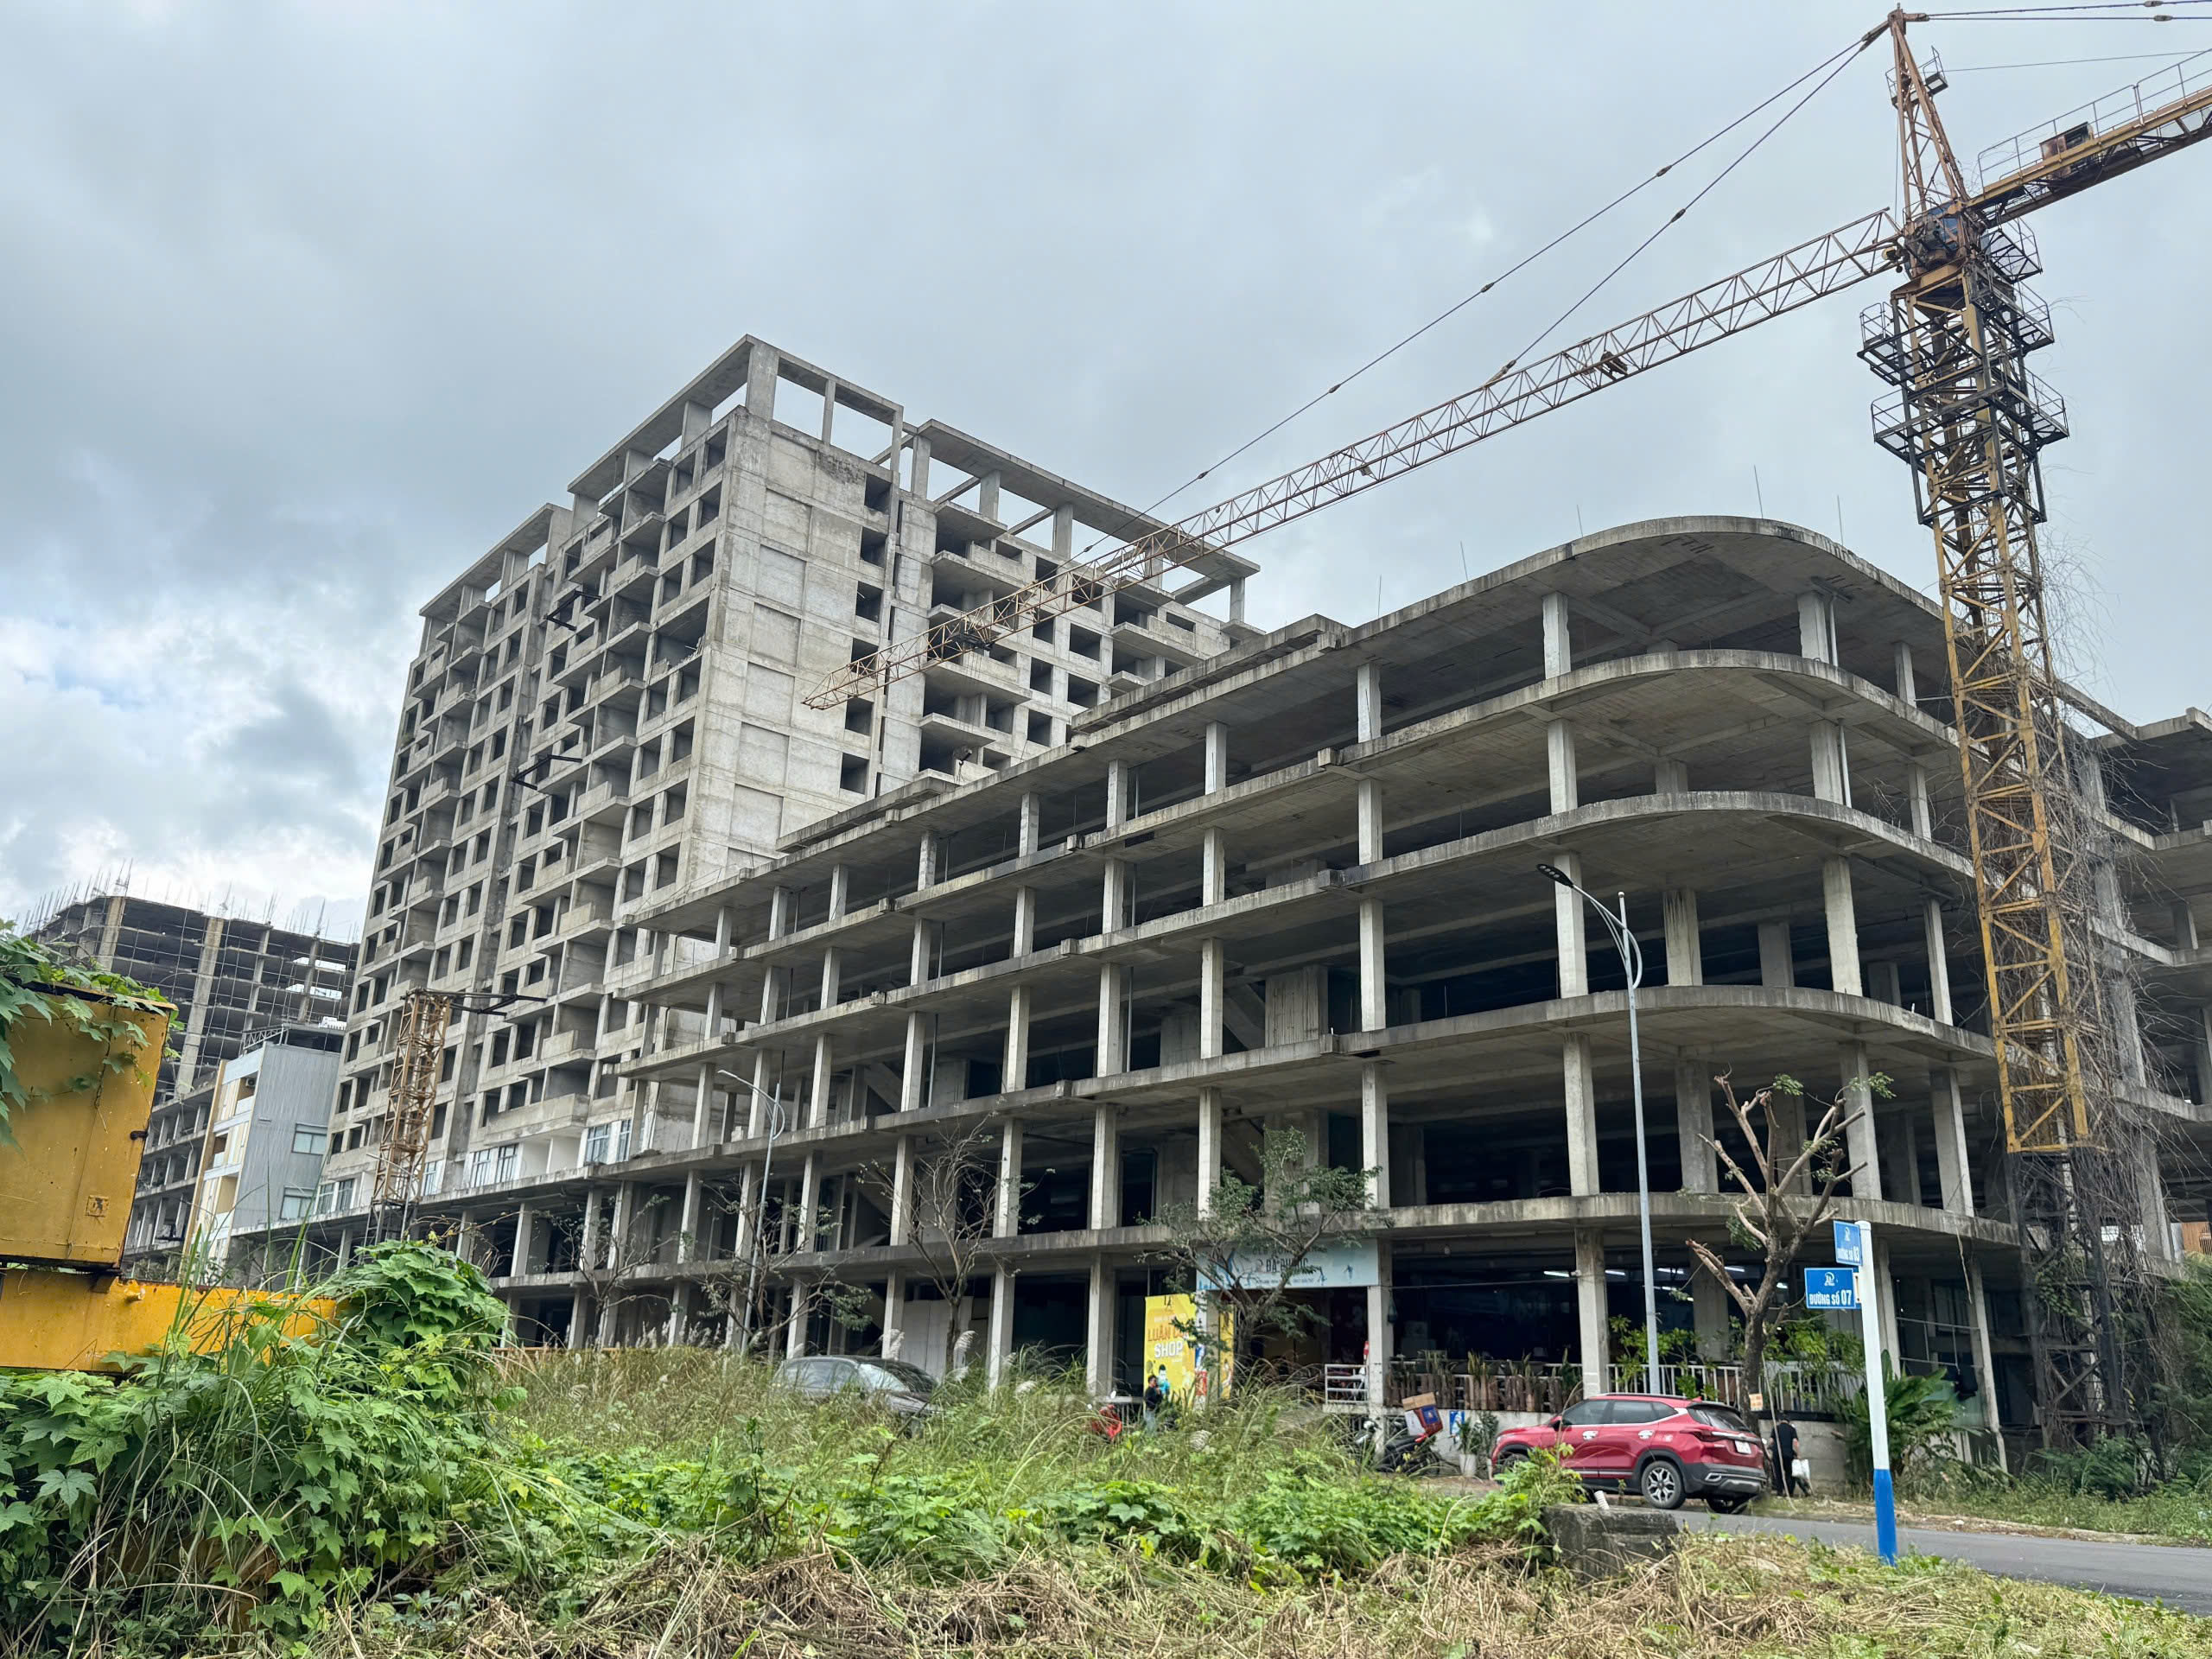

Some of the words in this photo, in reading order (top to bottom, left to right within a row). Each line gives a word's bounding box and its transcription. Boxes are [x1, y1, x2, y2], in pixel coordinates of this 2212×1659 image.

[1809, 1291, 1830, 1305] ĐƯỜNG
[1831, 1290, 1840, 1306] SỐ
[1841, 1289, 1852, 1306] 07
[1154, 1341, 1183, 1358] SHOP
